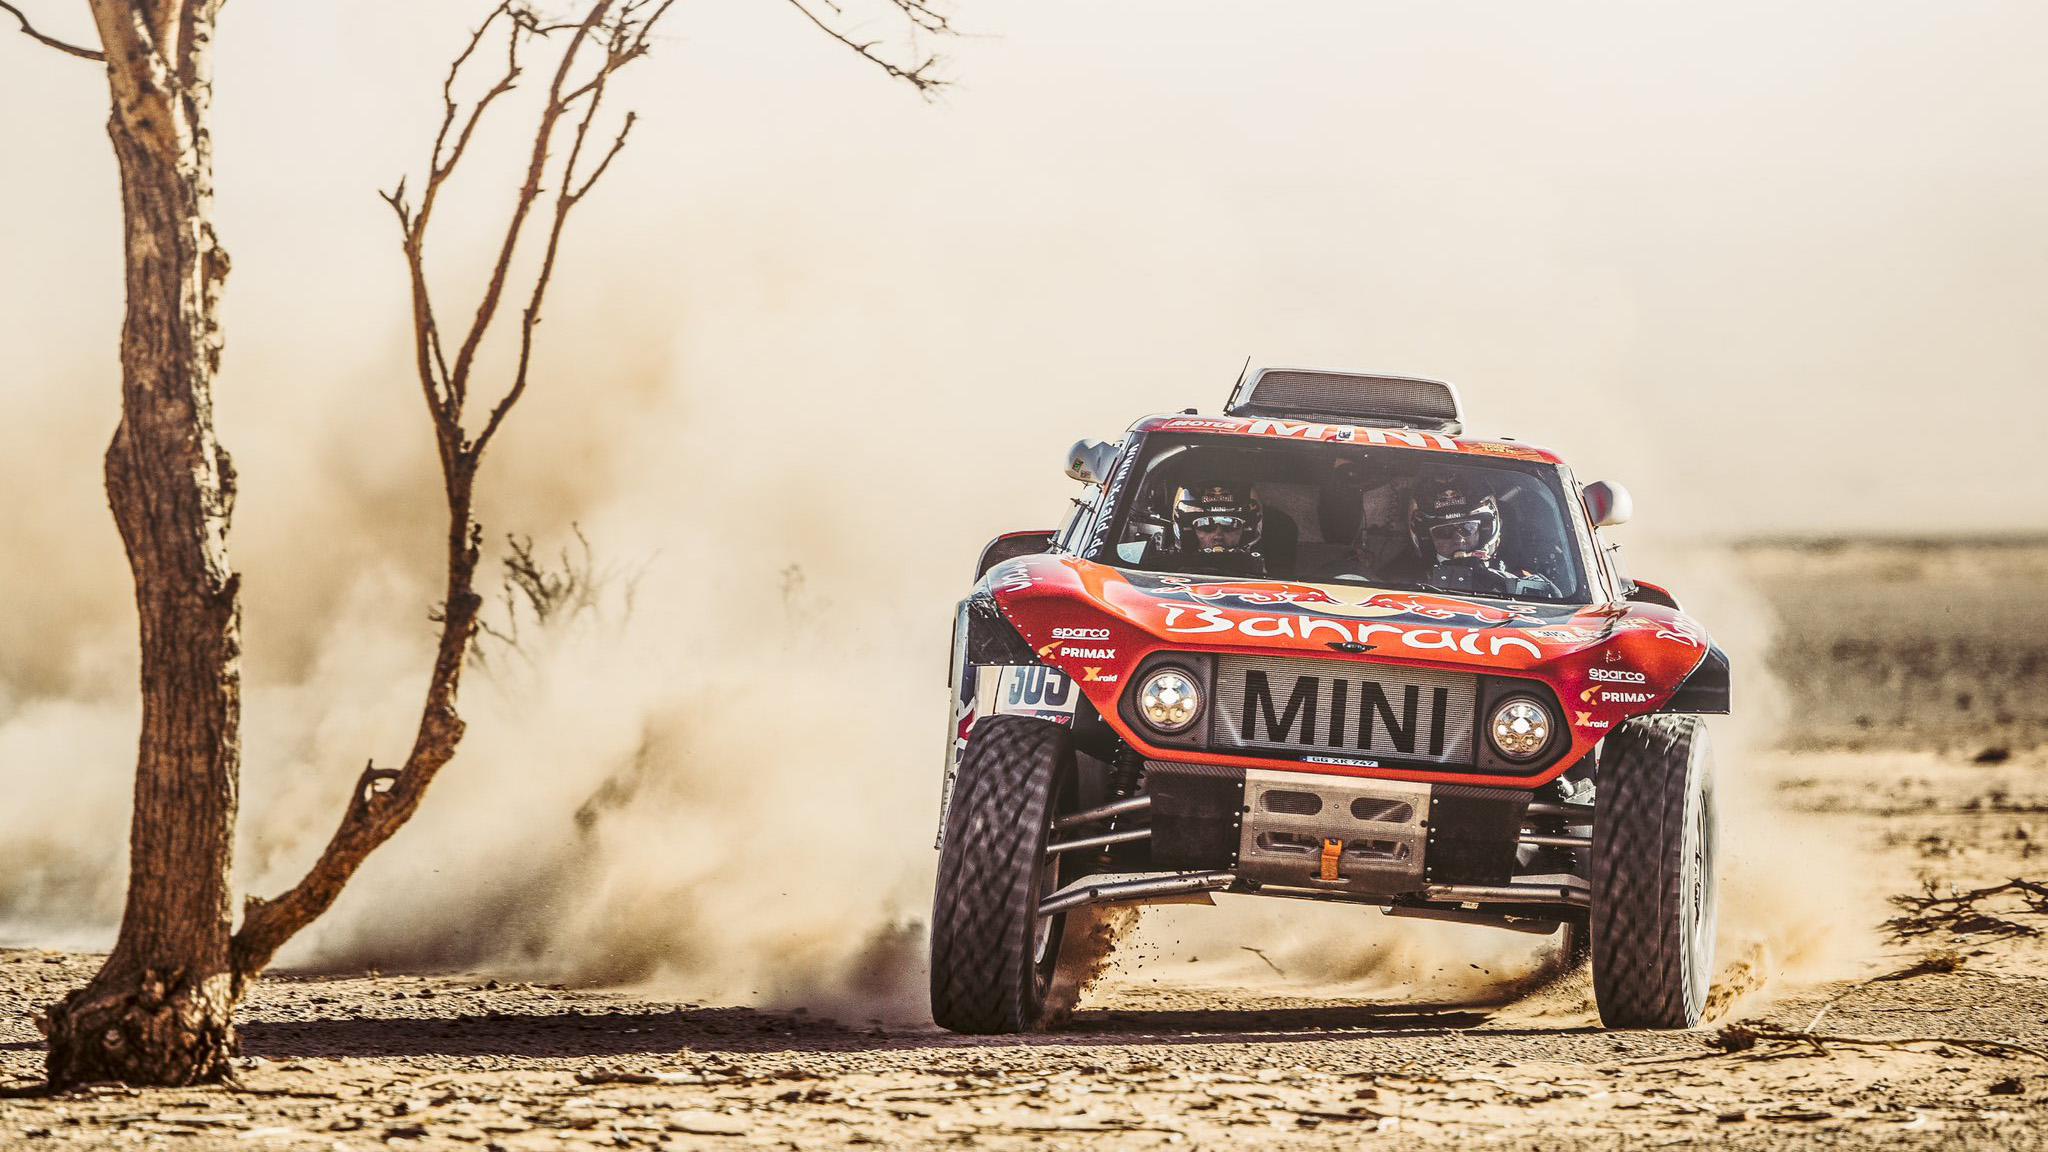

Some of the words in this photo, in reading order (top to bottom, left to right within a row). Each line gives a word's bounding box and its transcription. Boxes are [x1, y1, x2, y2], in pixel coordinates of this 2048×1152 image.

[1169, 420, 1237, 429] MOTUL
[1247, 419, 1459, 450] MINI
[1087, 443, 1139, 558] www.x-raid.de
[1052, 628, 1110, 639] sparco
[1157, 603, 1542, 659] Bahrain
[1060, 647, 1115, 659] PRIMAX
[1008, 666, 1073, 706] 305
[1589, 668, 1645, 682] sparco
[1241, 669, 1448, 757] MINI
